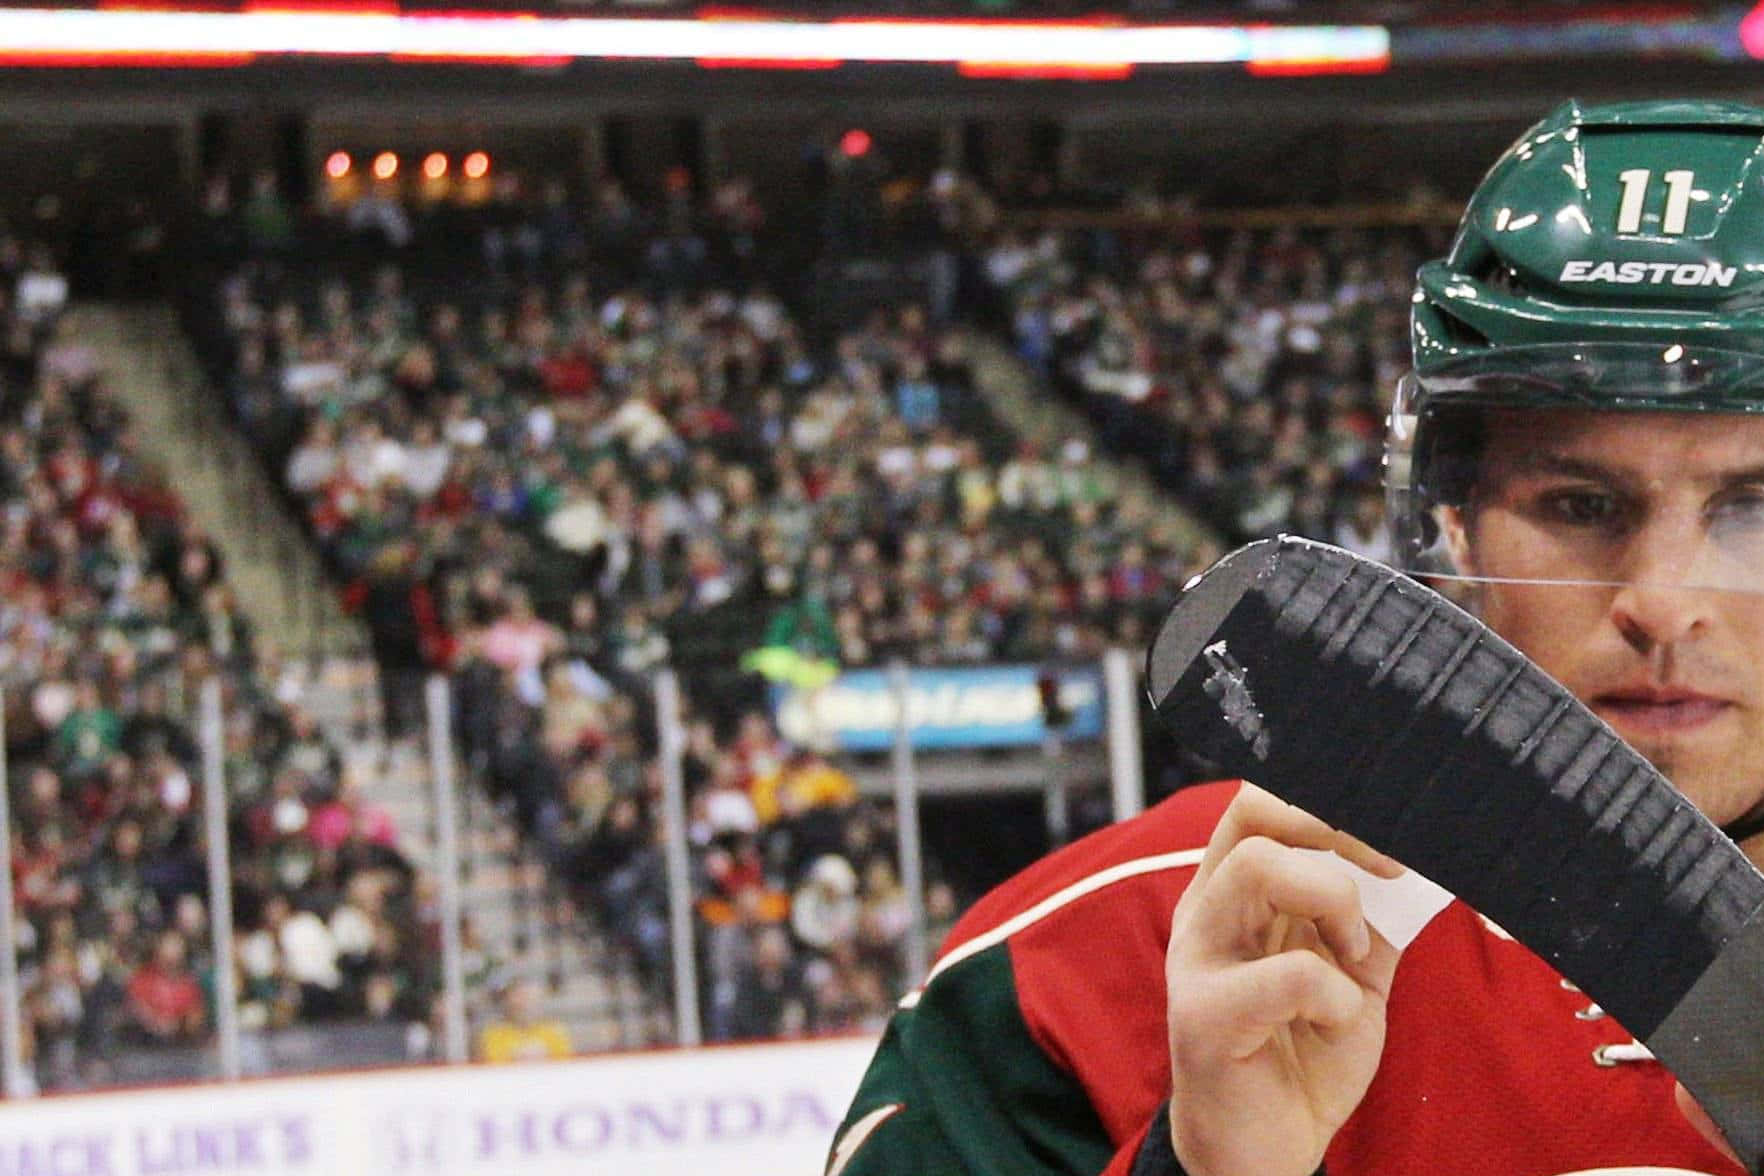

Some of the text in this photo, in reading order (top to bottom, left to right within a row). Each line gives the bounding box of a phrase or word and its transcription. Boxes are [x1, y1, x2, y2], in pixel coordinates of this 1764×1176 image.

[1616, 168, 1695, 235] 11
[1558, 260, 1738, 288] EASTON
[473, 1087, 834, 1162] HONDA
